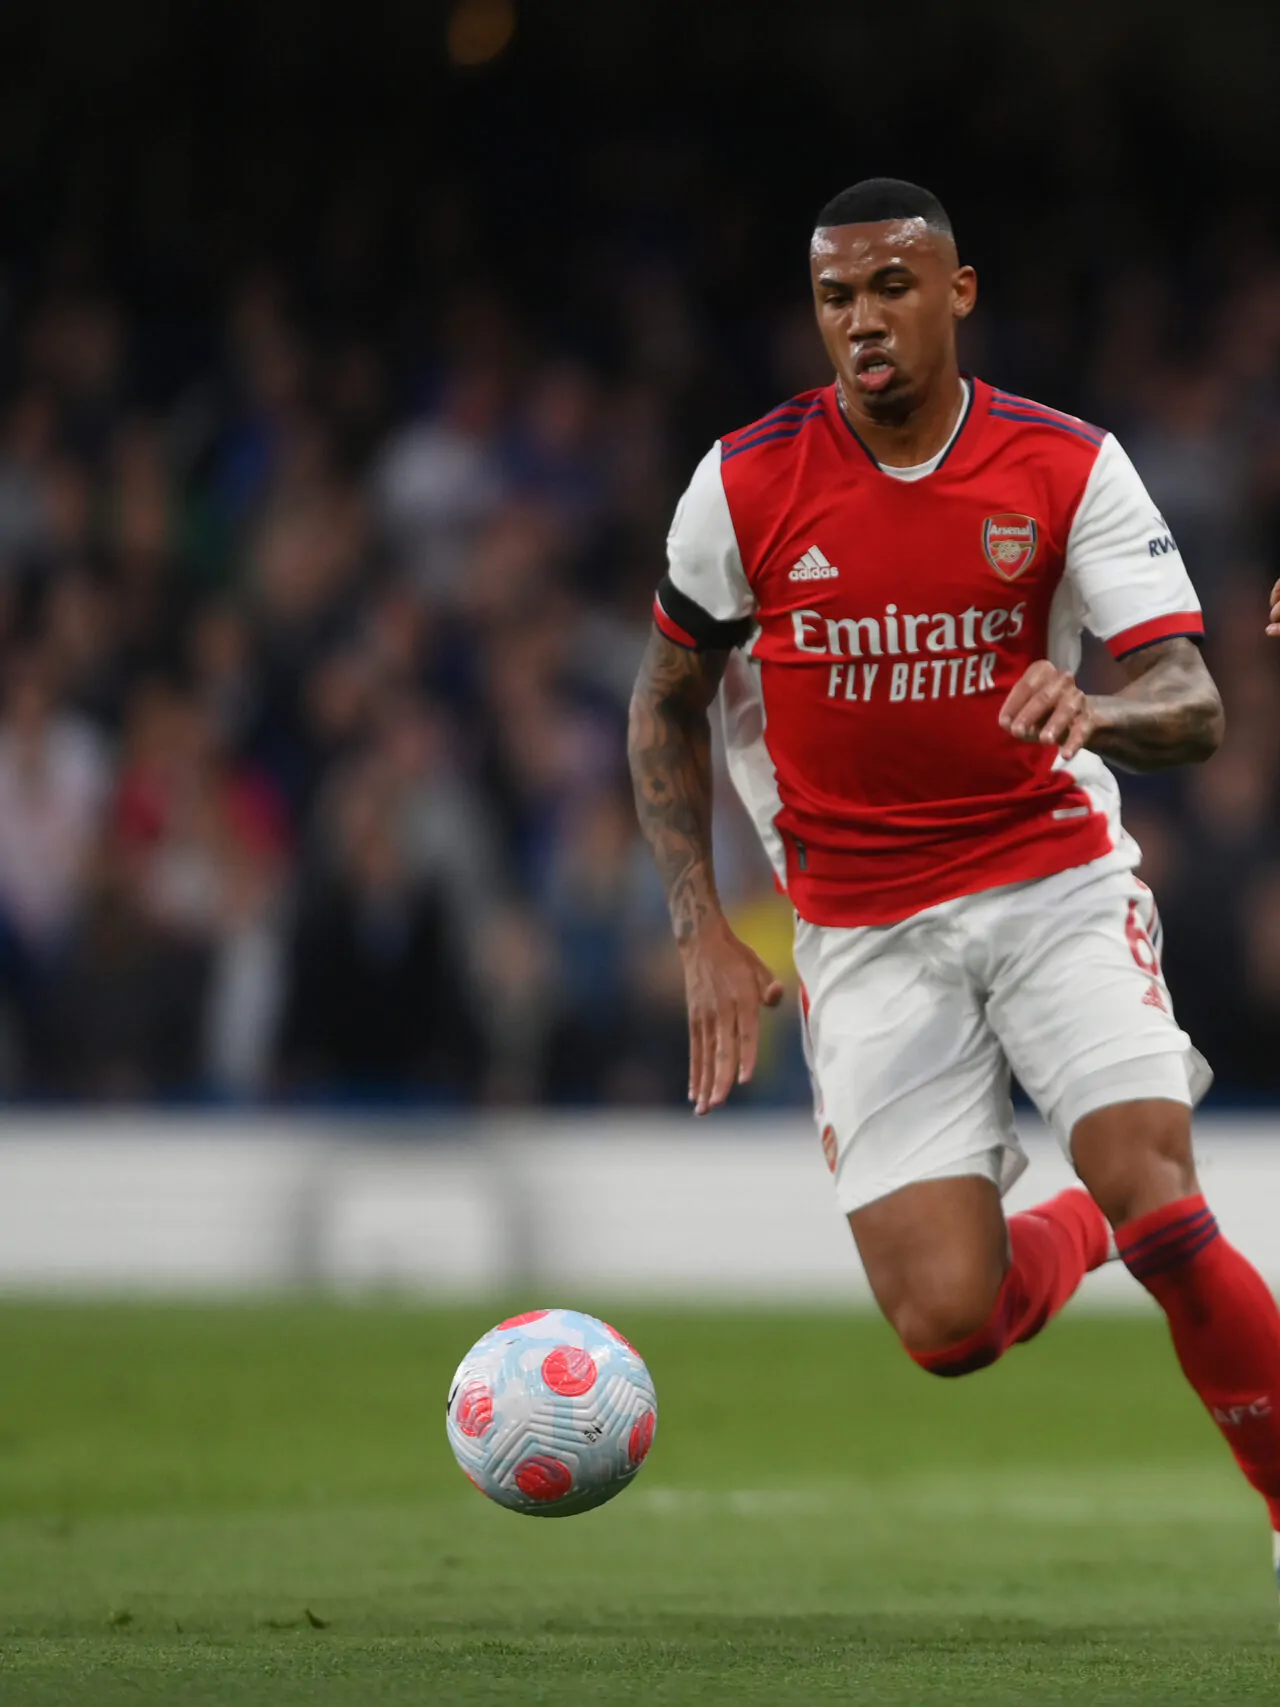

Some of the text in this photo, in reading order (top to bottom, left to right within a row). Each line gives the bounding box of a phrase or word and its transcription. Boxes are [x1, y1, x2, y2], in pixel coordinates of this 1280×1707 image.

[788, 566, 839, 582] adidas
[791, 601, 1027, 656] Emirates
[828, 651, 996, 702] FLY BETTER
